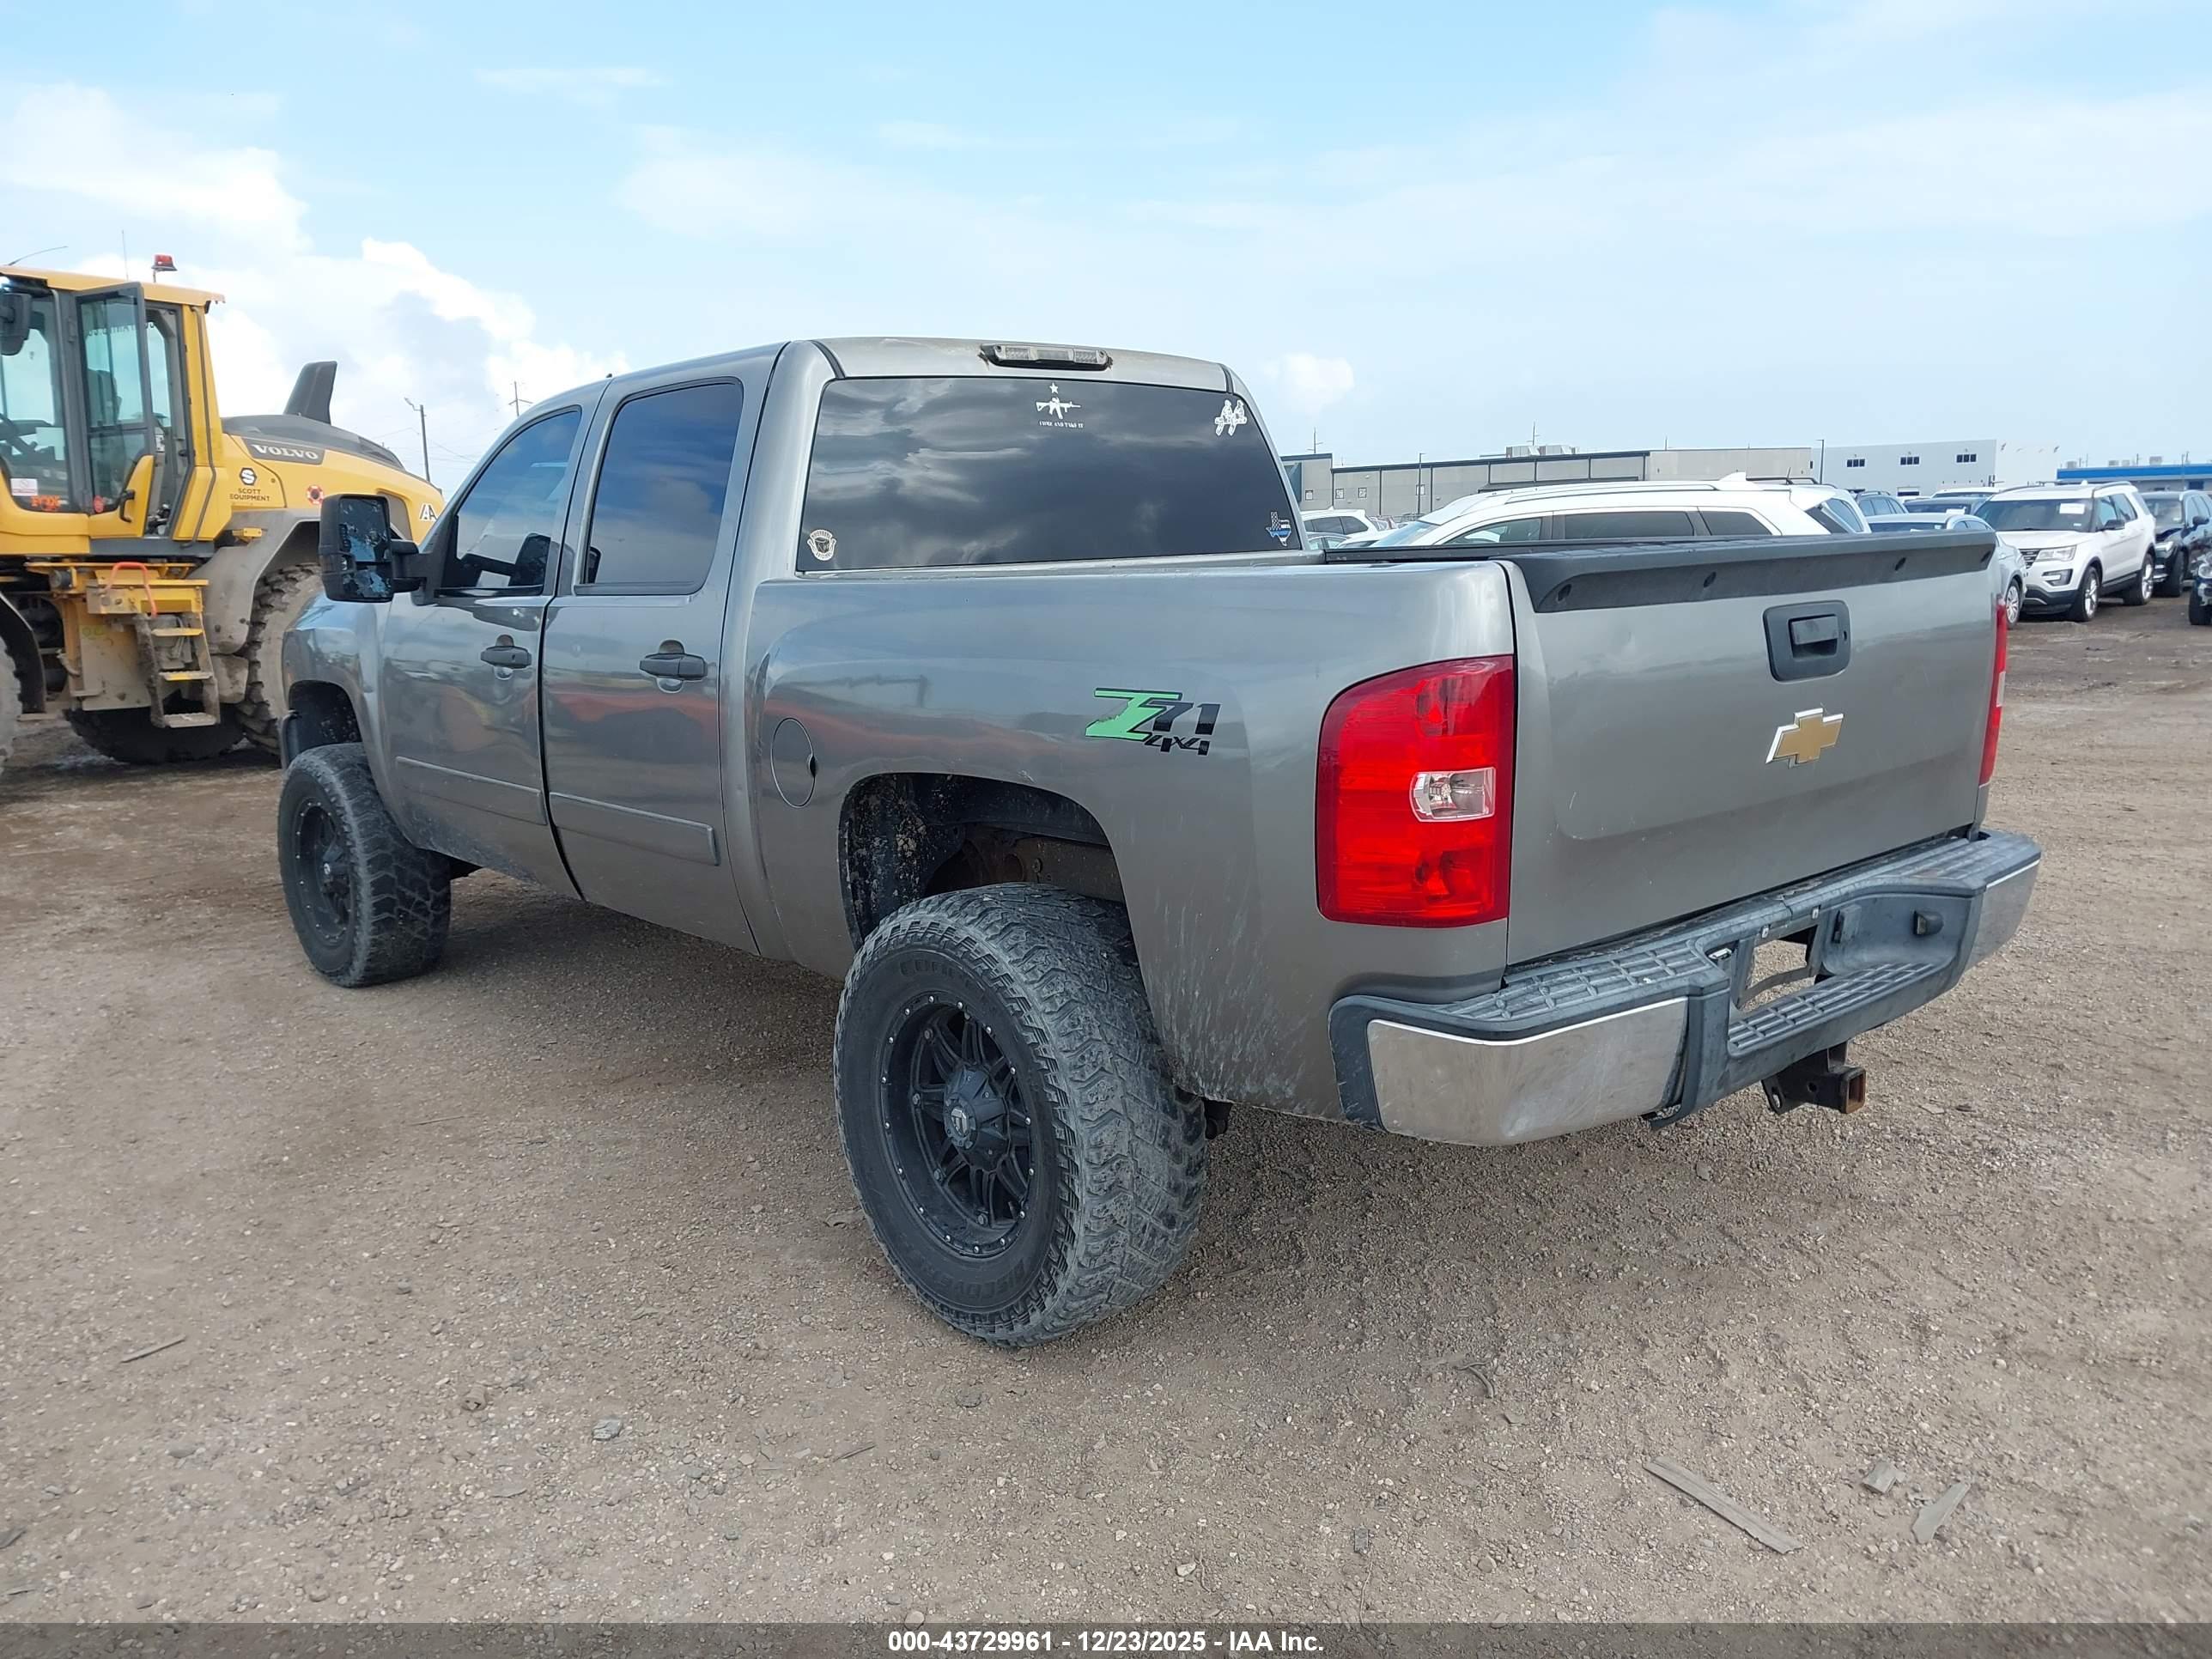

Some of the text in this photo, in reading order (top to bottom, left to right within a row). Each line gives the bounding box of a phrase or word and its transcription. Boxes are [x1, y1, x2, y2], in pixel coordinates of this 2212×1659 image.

[252, 444, 319, 459] VOLVO
[229, 493, 270, 501] EQUIPMENT
[1085, 687, 1221, 742] Z71
